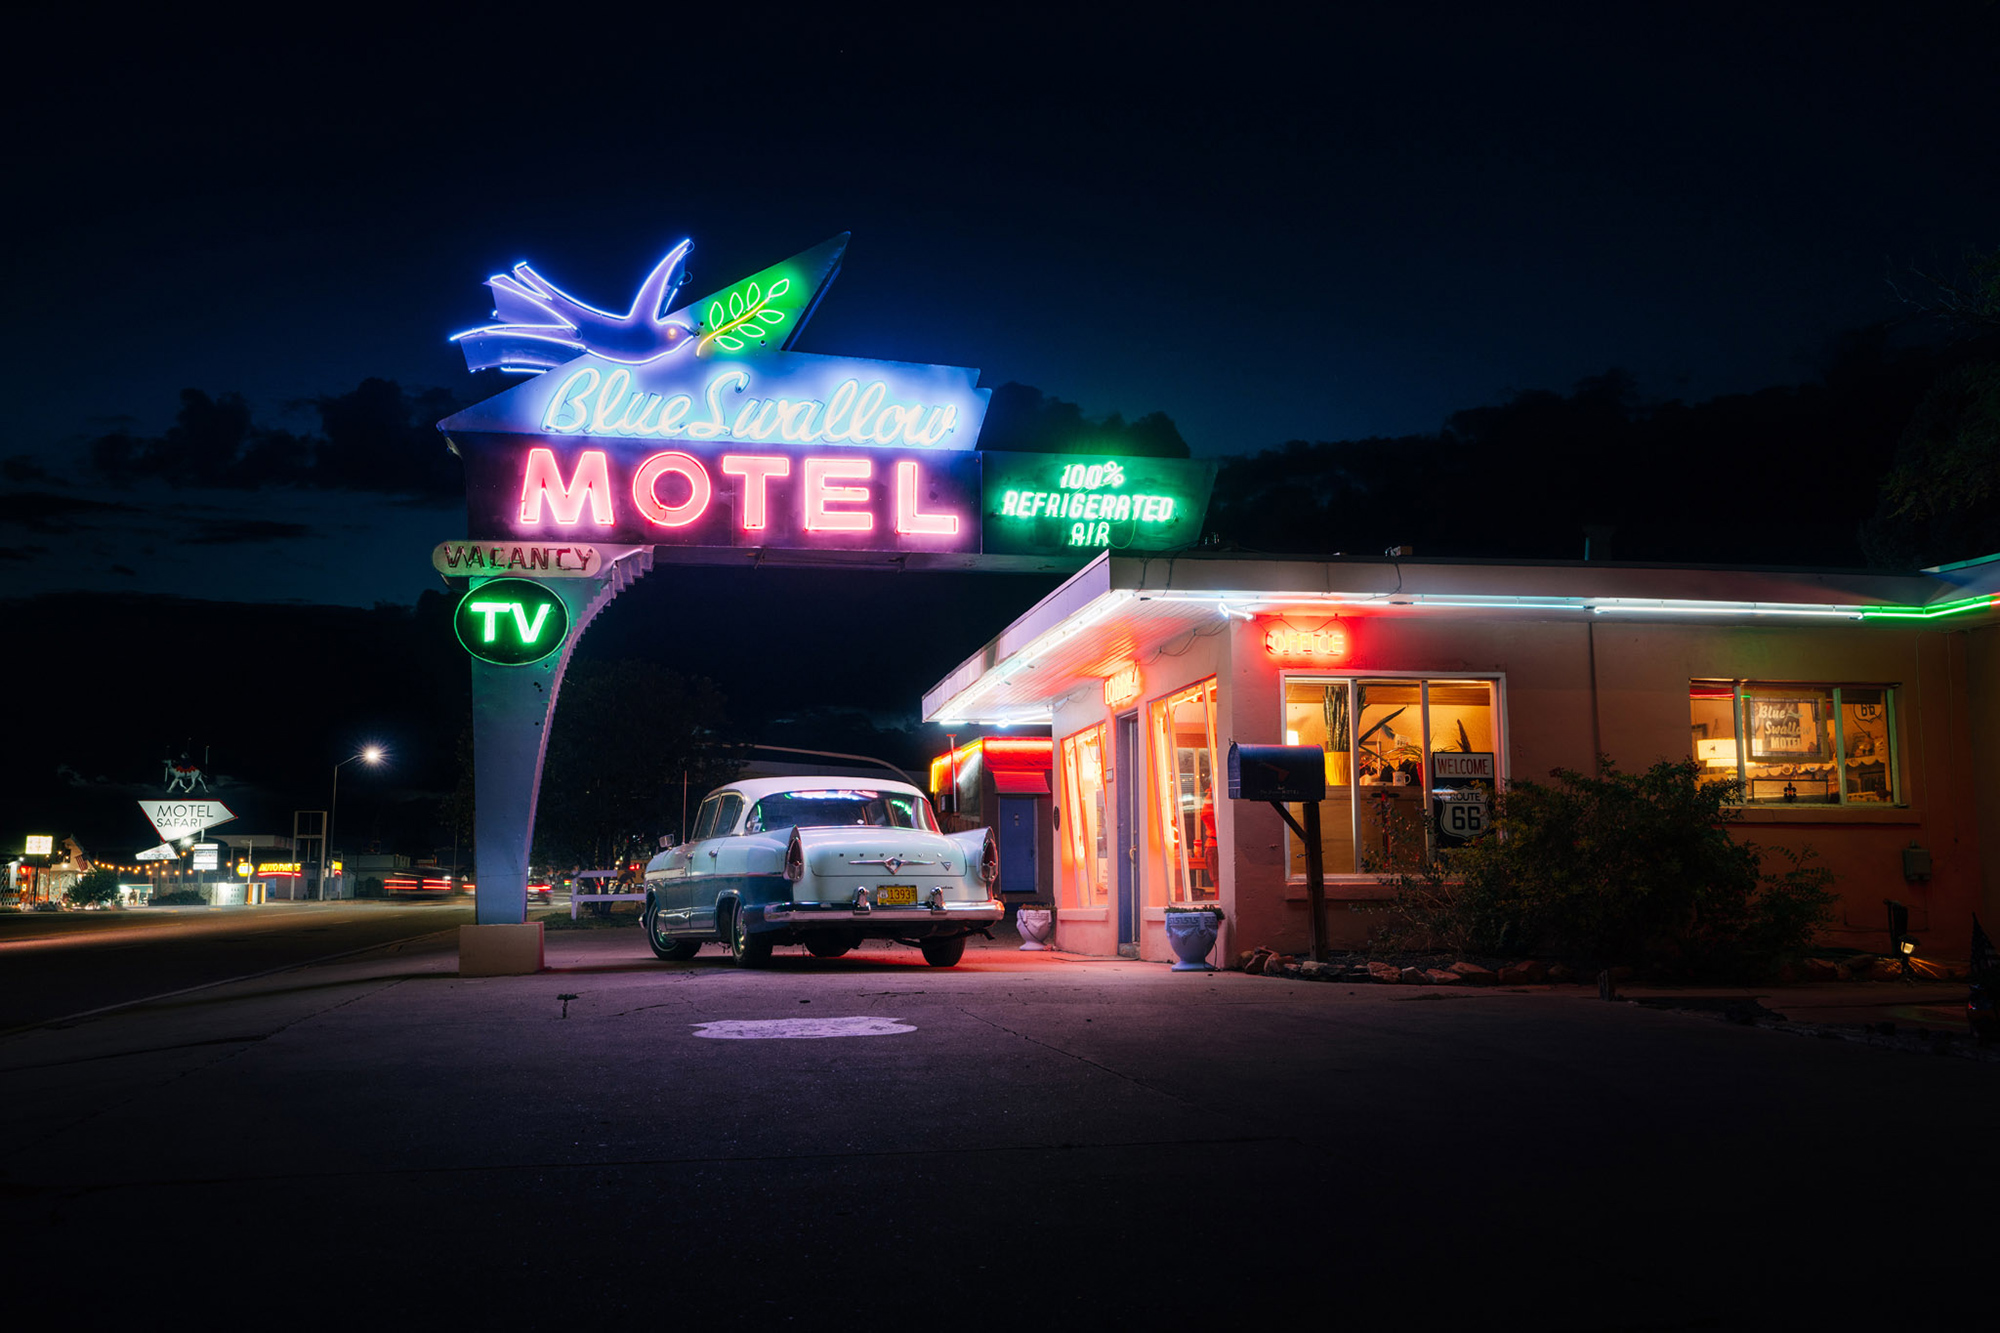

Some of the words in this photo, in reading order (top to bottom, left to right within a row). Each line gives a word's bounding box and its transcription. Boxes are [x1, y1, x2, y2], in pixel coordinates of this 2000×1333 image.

[540, 366, 692, 434] Blue
[684, 370, 959, 447] Swallow
[1060, 461, 1125, 490] 100%
[519, 447, 960, 535] MOTEL
[1002, 490, 1175, 522] REFRIGERATED
[1068, 521, 1111, 547] AIR
[444, 545, 594, 571] VACANCY
[470, 601, 551, 643] TV
[1269, 632, 1345, 655] OFFICE
[1757, 704, 1786, 719] Blue
[1765, 720, 1812, 736] Swallow
[1437, 758, 1490, 775] WELCOME
[1450, 792, 1481, 802] ROUTE
[156, 804, 214, 818] MOTEL
[156, 818, 202, 828] SAFARI
[1451, 805, 1481, 831] 66
[279, 862, 302, 872] PARS
